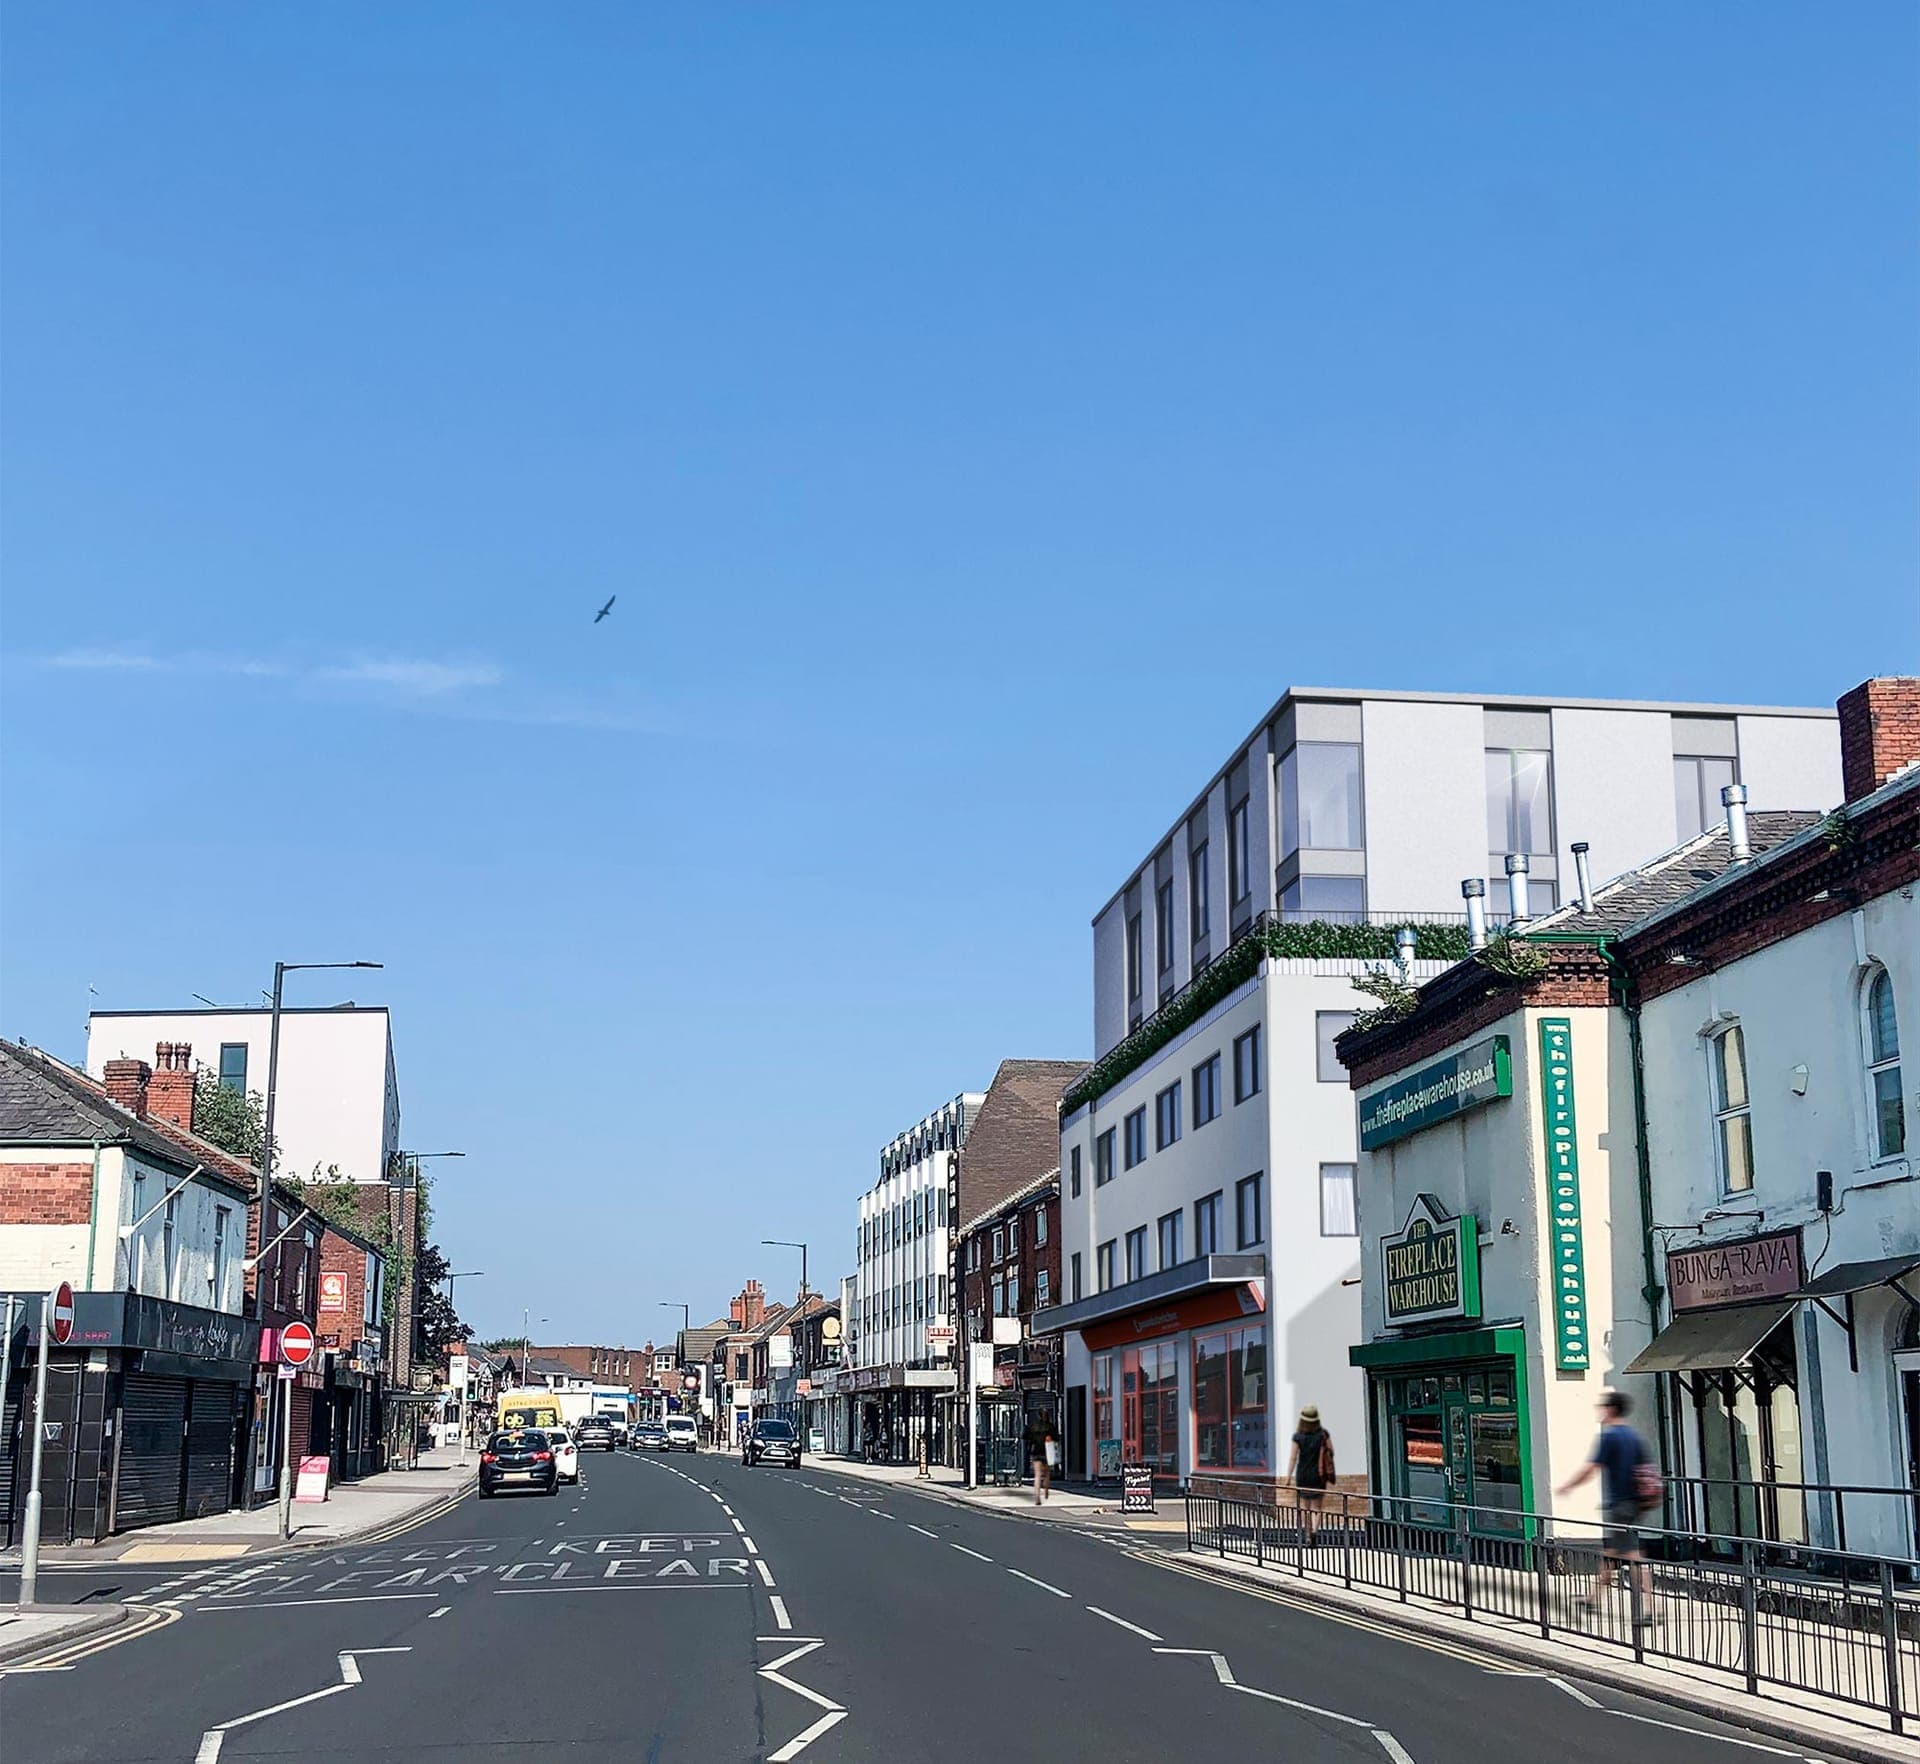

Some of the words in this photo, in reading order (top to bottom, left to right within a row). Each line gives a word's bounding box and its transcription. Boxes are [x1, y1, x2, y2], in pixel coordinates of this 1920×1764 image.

[1361, 1058, 1495, 1134] www.thefireplacewarehouse.co.uk
[1413, 1221, 1428, 1240] THE
[1388, 1235, 1456, 1281] FIREPLACE
[1674, 1250, 1732, 1286] BUNGA
[1736, 1239, 1793, 1276] RAYA
[1389, 1272, 1457, 1312] WAREHOUSE
[548, 1538, 720, 1555] KEEP
[208, 1563, 490, 1599] CLEAR
[500, 1557, 751, 1582] CLEAR
